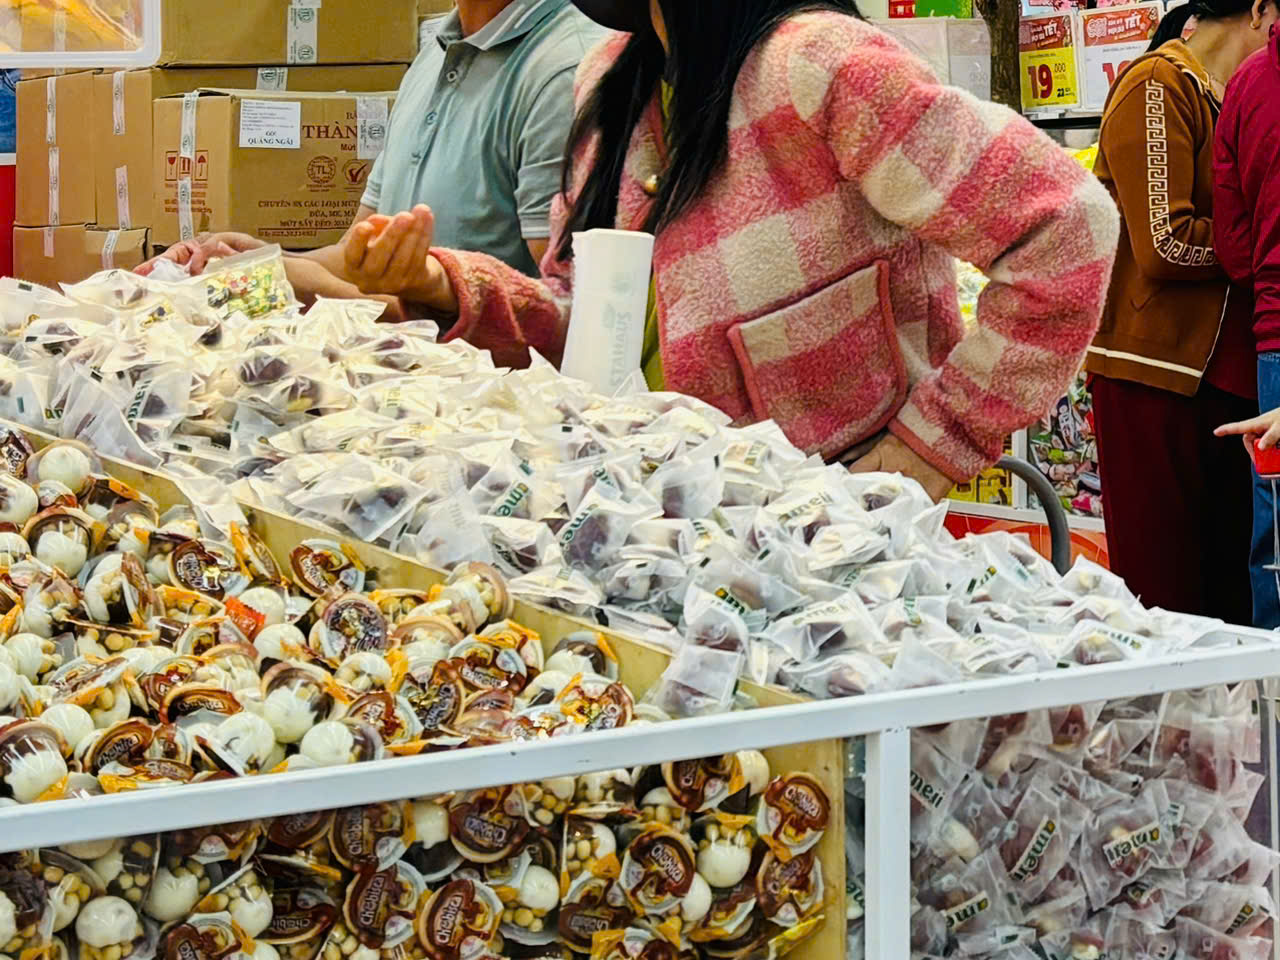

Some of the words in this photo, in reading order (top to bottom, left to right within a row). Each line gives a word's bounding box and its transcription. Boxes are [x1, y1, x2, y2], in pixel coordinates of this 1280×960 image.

[1027, 64, 1053, 99] 19
[302, 121, 358, 139] THÀN
[909, 770, 944, 809] meii
